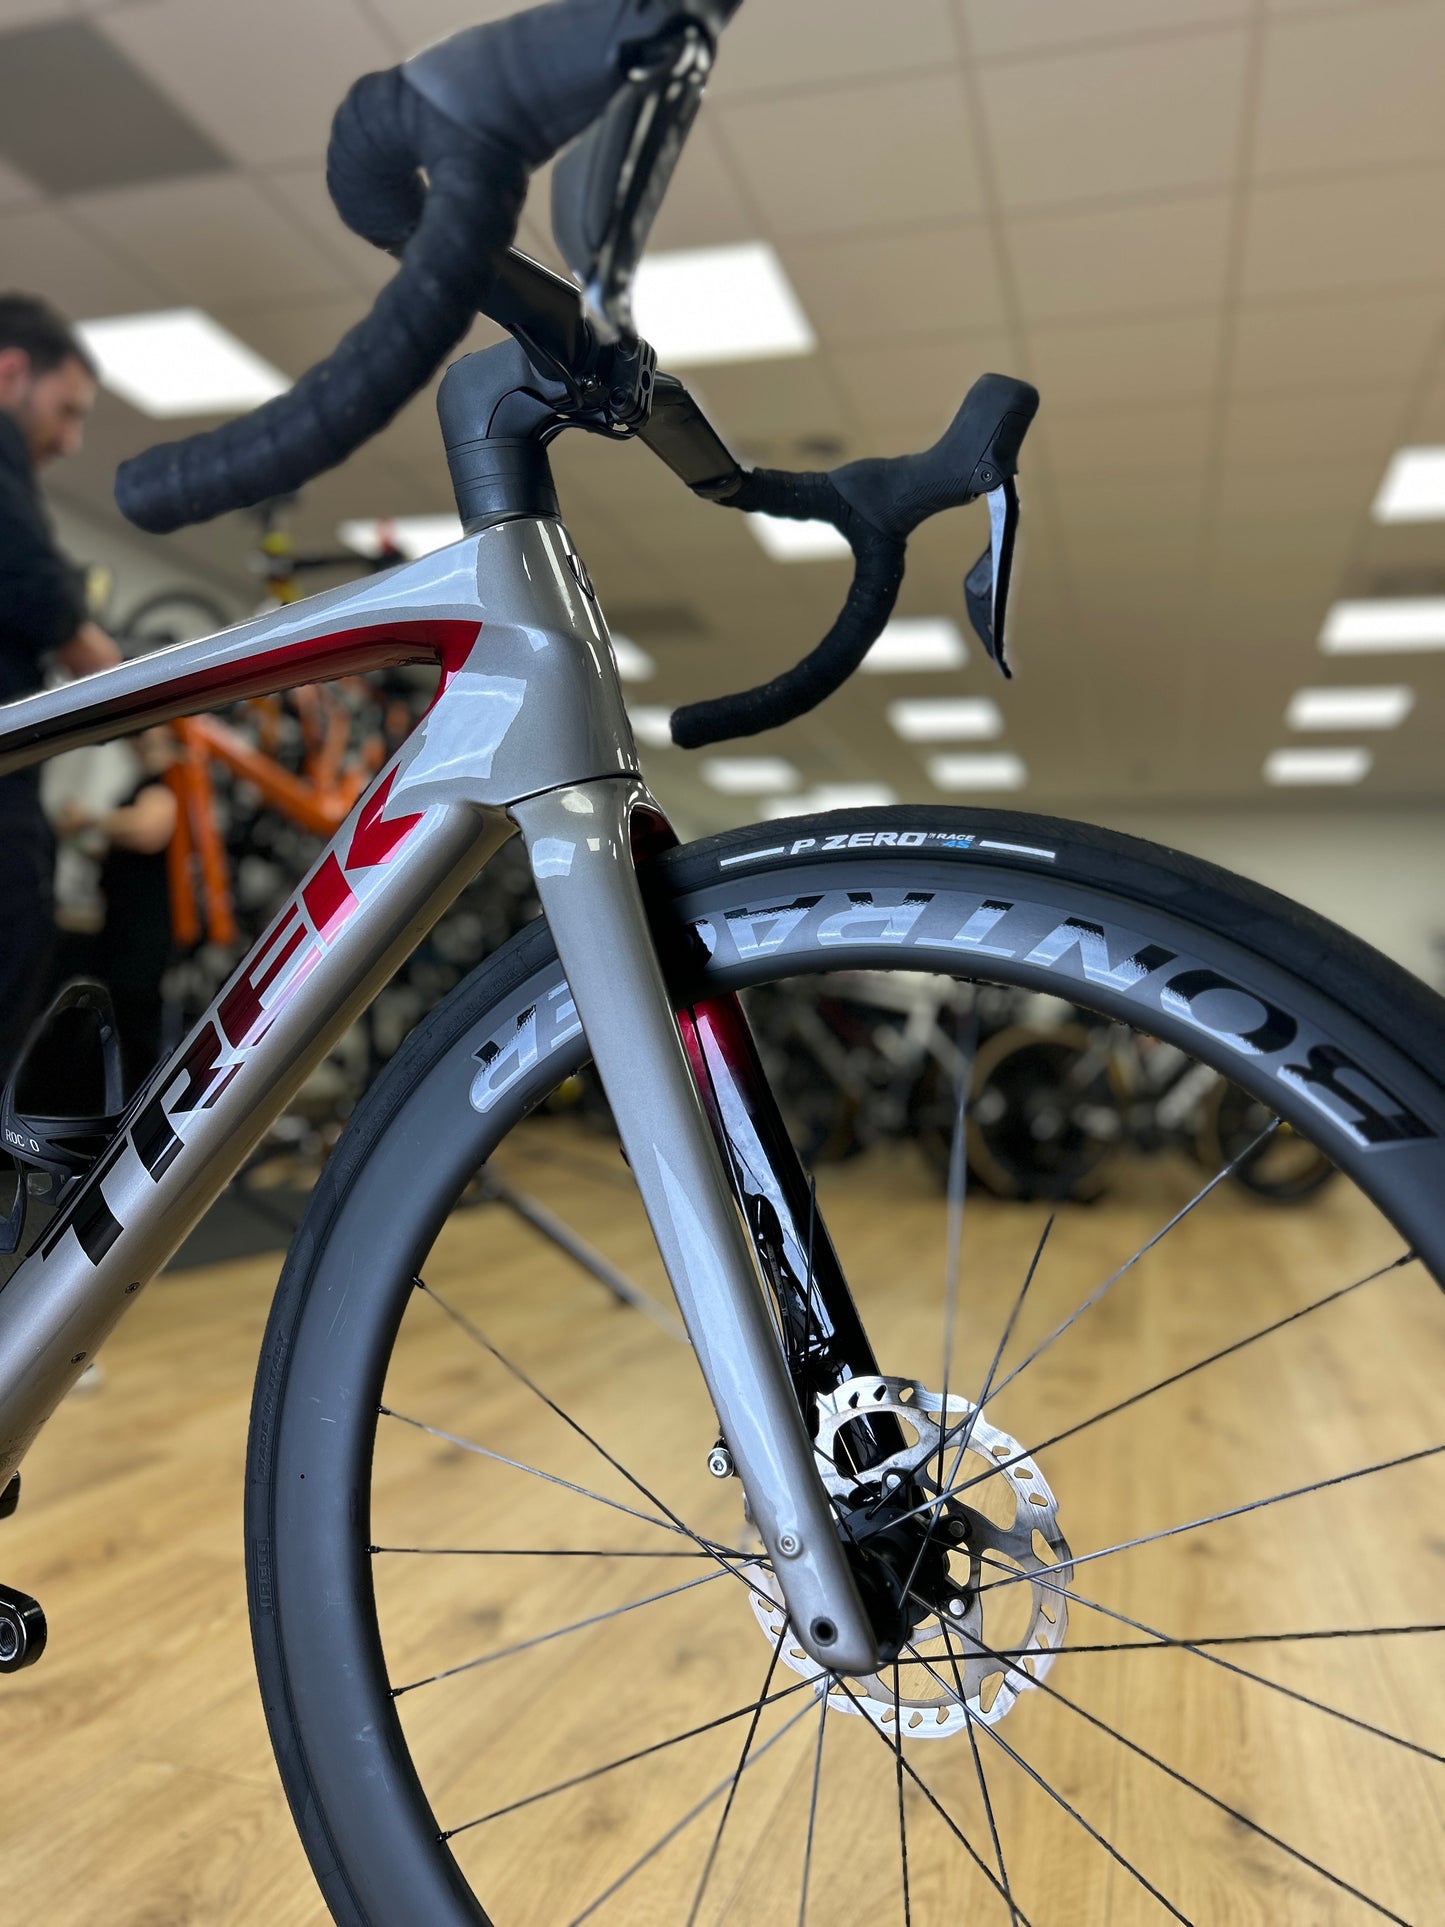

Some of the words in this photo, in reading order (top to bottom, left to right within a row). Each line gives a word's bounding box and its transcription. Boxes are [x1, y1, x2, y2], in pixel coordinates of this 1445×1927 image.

[791, 838, 816, 854] P
[936, 833, 976, 841] RACE
[42, 761, 427, 1267] TREK
[470, 891, 1440, 1147] BONTRAER
